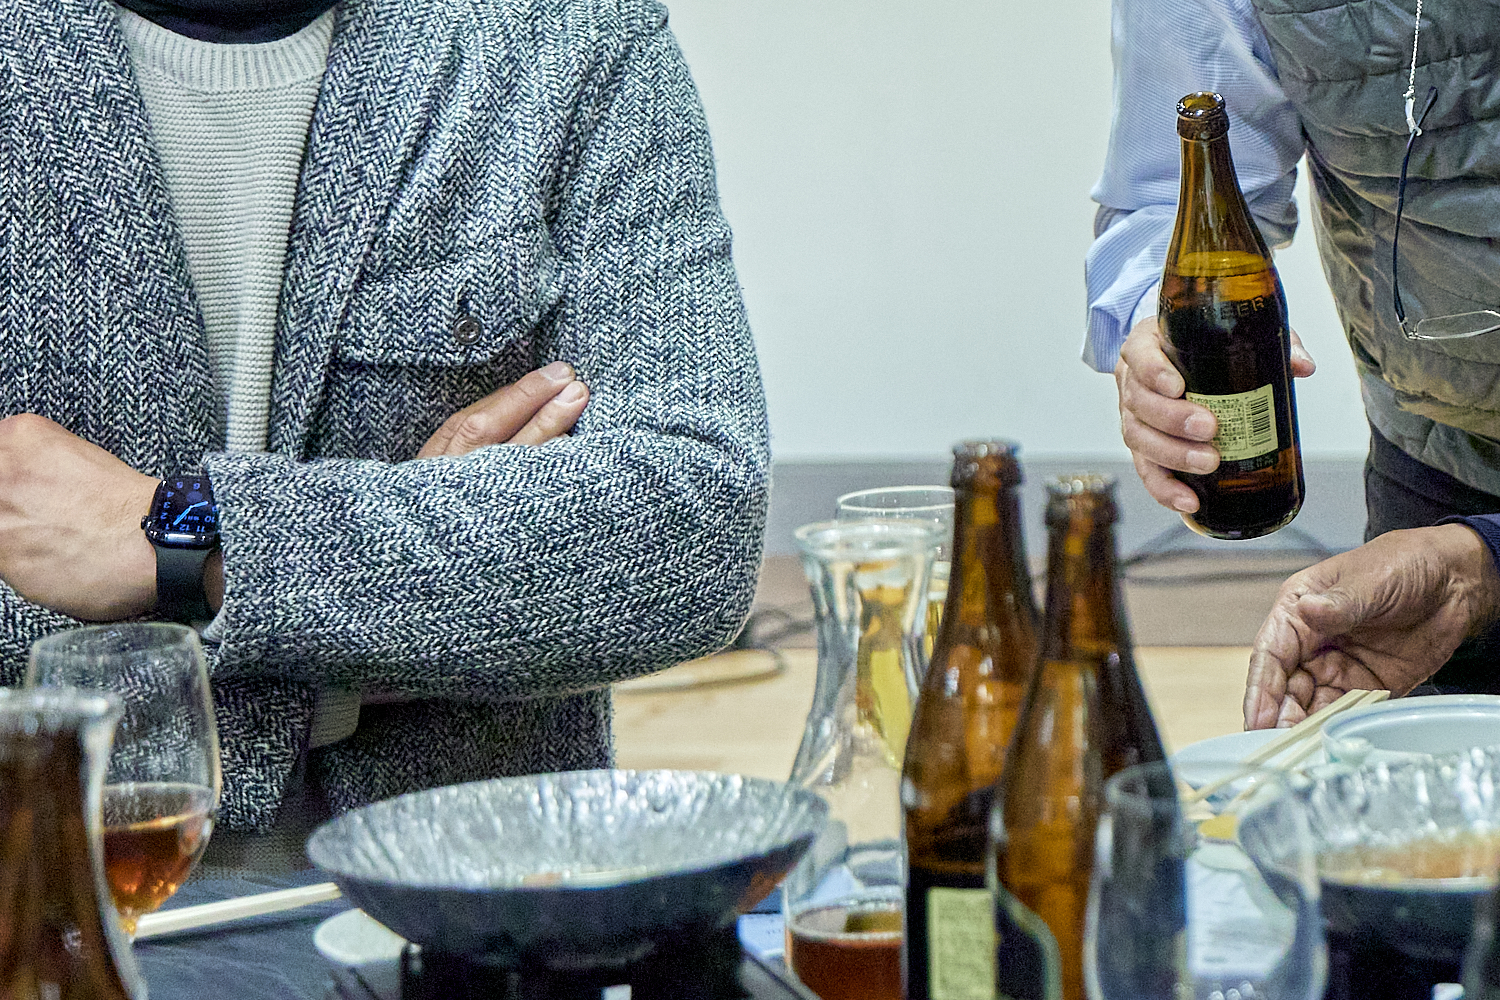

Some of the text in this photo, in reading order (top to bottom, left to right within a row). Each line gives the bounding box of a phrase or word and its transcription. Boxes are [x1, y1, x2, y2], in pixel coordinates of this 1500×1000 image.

[193, 482, 200, 490] 6
[163, 501, 171, 509] 3
[160, 512, 168, 520] 2
[204, 515, 215, 523] 10
[179, 523, 190, 531] 12
[196, 525, 205, 533] 11
